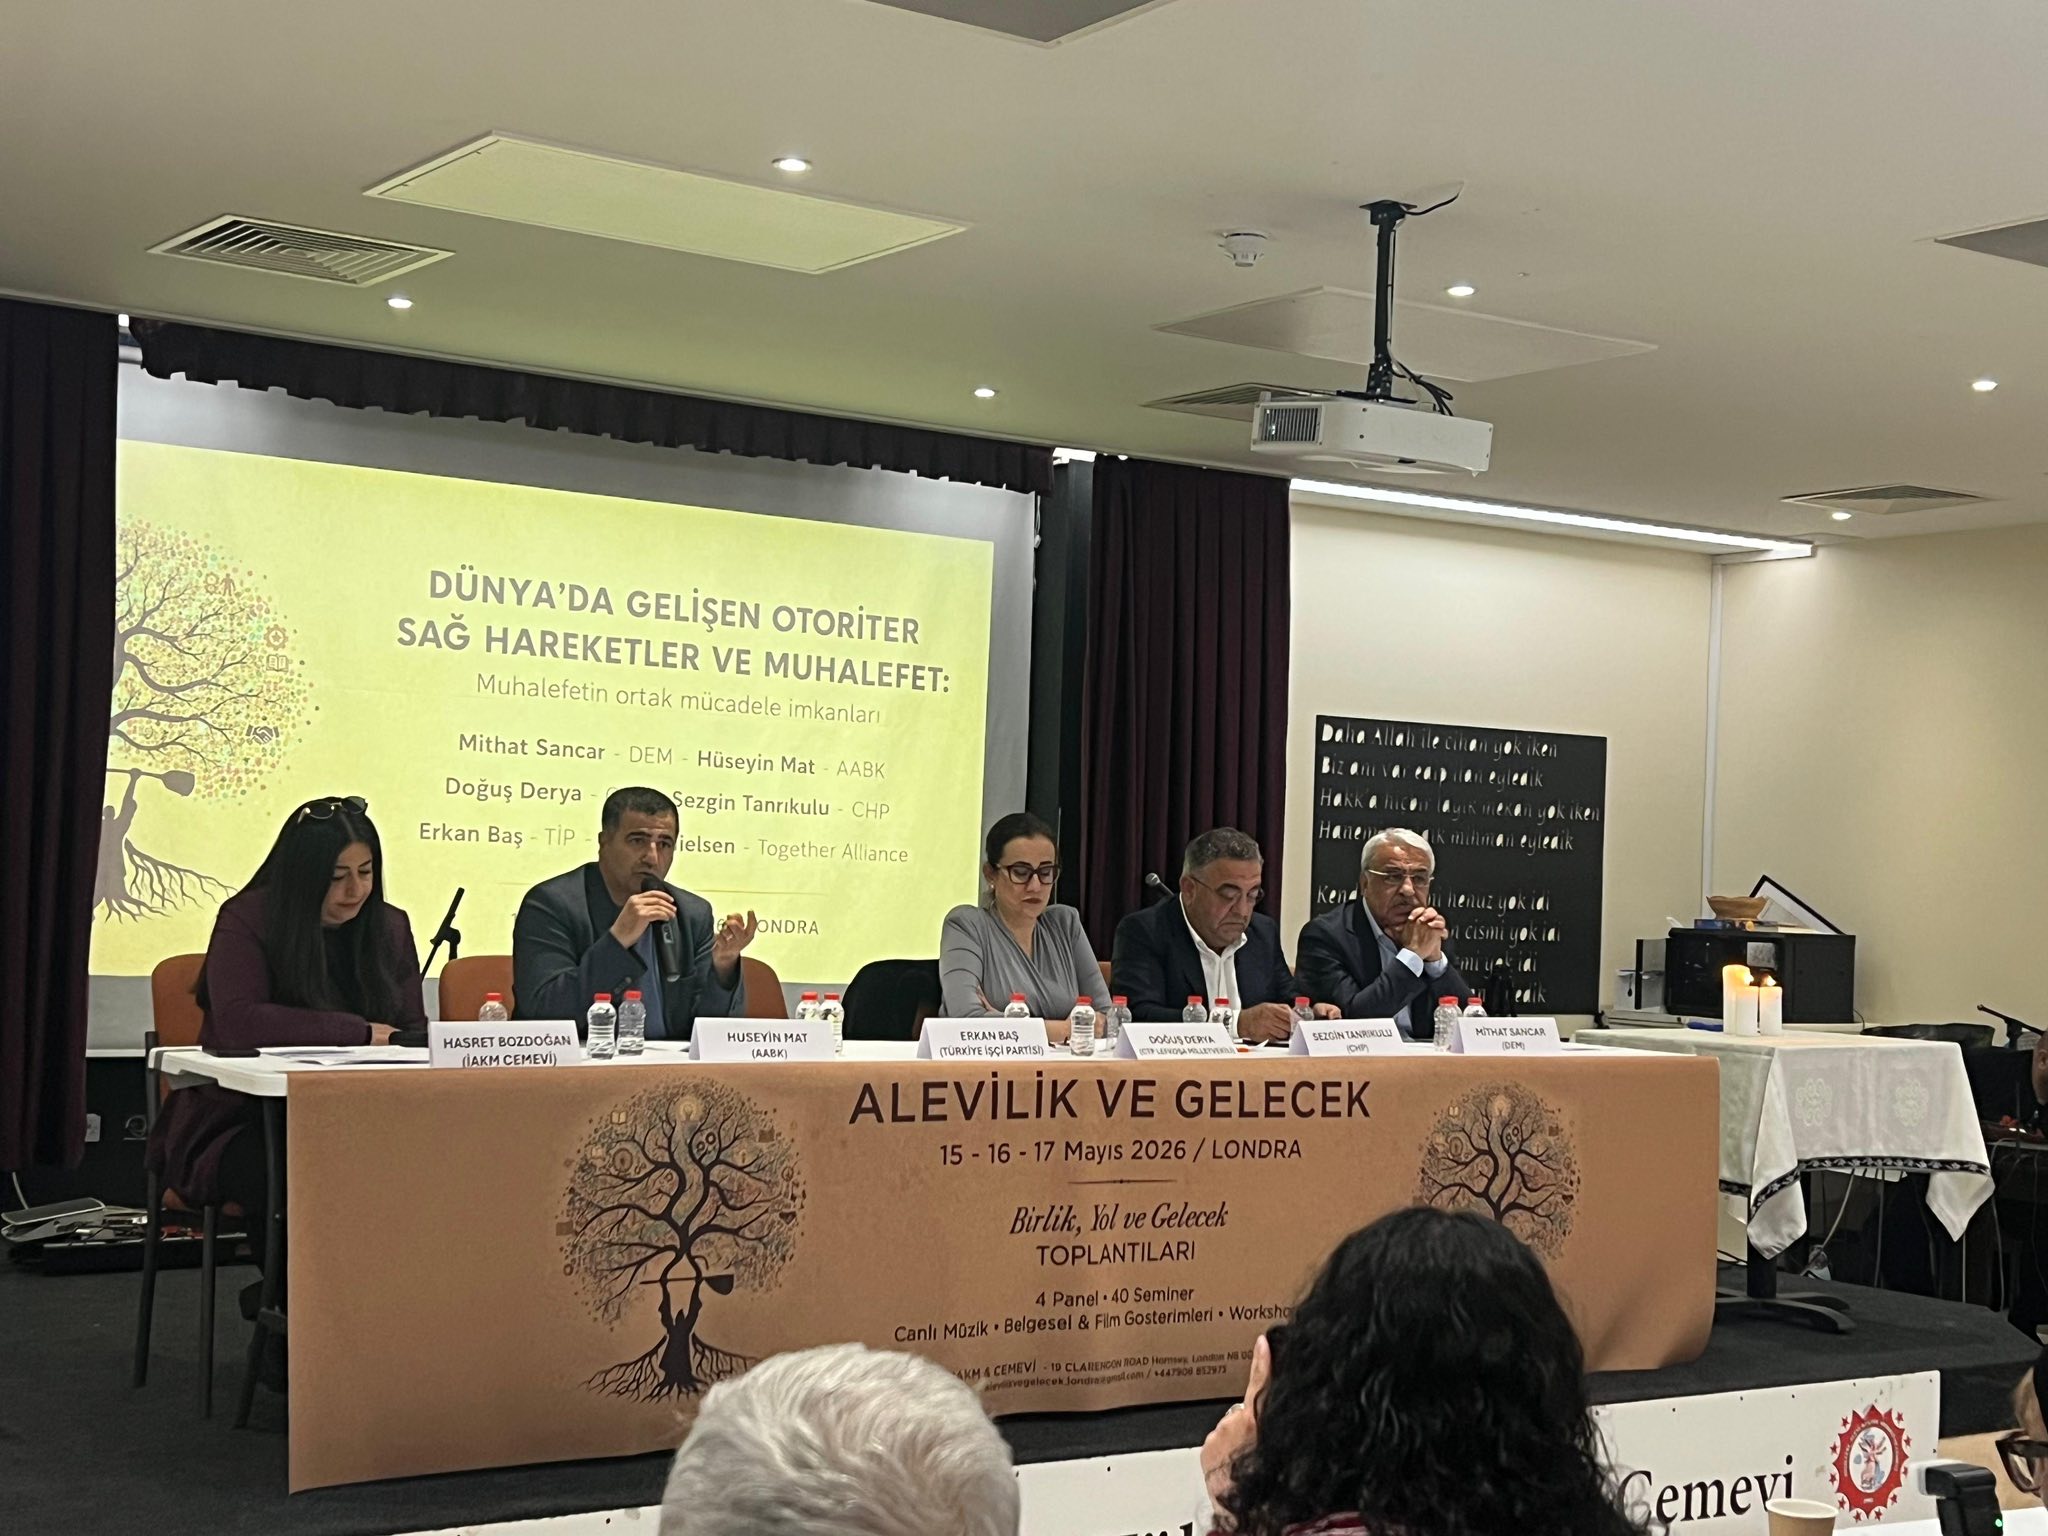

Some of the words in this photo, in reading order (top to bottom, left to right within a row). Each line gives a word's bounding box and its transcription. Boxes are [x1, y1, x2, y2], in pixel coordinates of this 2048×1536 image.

[429, 564, 614, 617] DÜNYA'DA
[626, 587, 761, 633] GELİŞEN
[772, 605, 919, 645] OTORİTER
[398, 613, 471, 651] SAĞ
[485, 624, 700, 672] HAREKETLER
[713, 646, 751, 676] VE
[765, 651, 951, 693] MUHALEFET:
[477, 673, 608, 704] Muhalefetin
[616, 686, 673, 710] ortak
[680, 690, 781, 718] mücadele
[788, 697, 880, 724] imkanları
[1322, 722, 1365, 744] Daha
[1373, 724, 1415, 748] Allah
[1493, 735, 1521, 762] yok
[1527, 735, 1557, 758] iken
[459, 733, 528, 757] Mithat
[536, 737, 606, 761] Sancar
[629, 746, 672, 765] DEM
[697, 750, 774, 776] Hüseyin
[780, 754, 815, 775] Mat
[836, 760, 886, 780] AABK
[445, 777, 512, 803] Doğuş
[520, 781, 582, 804] Derya
[672, 791, 736, 815] Sezgin
[742, 795, 830, 816] Tanrıkulu
[852, 801, 890, 820] CHP
[419, 823, 480, 843] Erkan
[487, 826, 523, 849] Baş
[544, 825, 575, 845] TİP
[680, 834, 736, 855] ielsen
[757, 838, 836, 863] Together
[842, 843, 909, 864] Alliance
[1498, 888, 1526, 917] yok
[757, 919, 819, 935] ONDRA
[1510, 920, 1538, 949] yok
[443, 1035, 495, 1049] HASRET
[498, 1032, 571, 1047] BOZDOĞAN
[784, 1032, 808, 1043] MAT
[960, 1030, 995, 1042] ERKAN
[998, 1031, 1019, 1043] BAŞ
[1148, 1034, 1184, 1045] DOĞUŞ
[1184, 1035, 1216, 1045] DERYA
[1312, 1030, 1345, 1041] SEZGİN
[1346, 1029, 1393, 1040] TANRIKULU
[1475, 1026, 1508, 1037] MİTHAT
[1510, 1027, 1546, 1037] SANCAR
[461, 1053, 500, 1068] (İAKM
[502, 1050, 557, 1067] CEMEVİ)
[751, 1048, 788, 1060] (AABK)
[939, 1046, 982, 1058] (TÜRKİYE
[984, 1044, 1003, 1058] İŞÇİ
[1005, 1045, 1045, 1057] PARTİSİ)
[1346, 1044, 1370, 1054] (CHP)
[1502, 1041, 1526, 1051] (DEM)
[849, 1070, 1079, 1125] ALEVİLİK
[1097, 1078, 1157, 1119] VE
[1174, 1080, 1371, 1119] GELECEK
[940, 1145, 963, 1165] 15
[988, 1143, 1010, 1164] 16
[1035, 1142, 1055, 1162] 17
[1064, 1141, 1123, 1165] Mayıs
[1131, 1139, 1187, 1161] 2026
[1212, 1138, 1302, 1159] LONDRA
[1009, 1204, 1082, 1237] Birlik,
[1090, 1203, 1119, 1231] Yol
[1123, 1212, 1146, 1229] ve
[1151, 1201, 1228, 1229] Gelecek
[1036, 1240, 1196, 1266] TOPLANTILARI
[1035, 1292, 1046, 1307] 4
[1053, 1289, 1098, 1307] Panel
[1111, 1288, 1129, 1304] 40
[1134, 1286, 1194, 1303] Seminer
[894, 1326, 937, 1343] Canlı
[1005, 1315, 1072, 1336] Belgesel
[1078, 1318, 1089, 1331] &
[1095, 1314, 1121, 1330] Film
[1229, 1303, 1292, 1321] Worksho
[994, 1359, 1036, 1377] CEMEVİ
[1618, 1454, 1794, 1523] Cemevi
